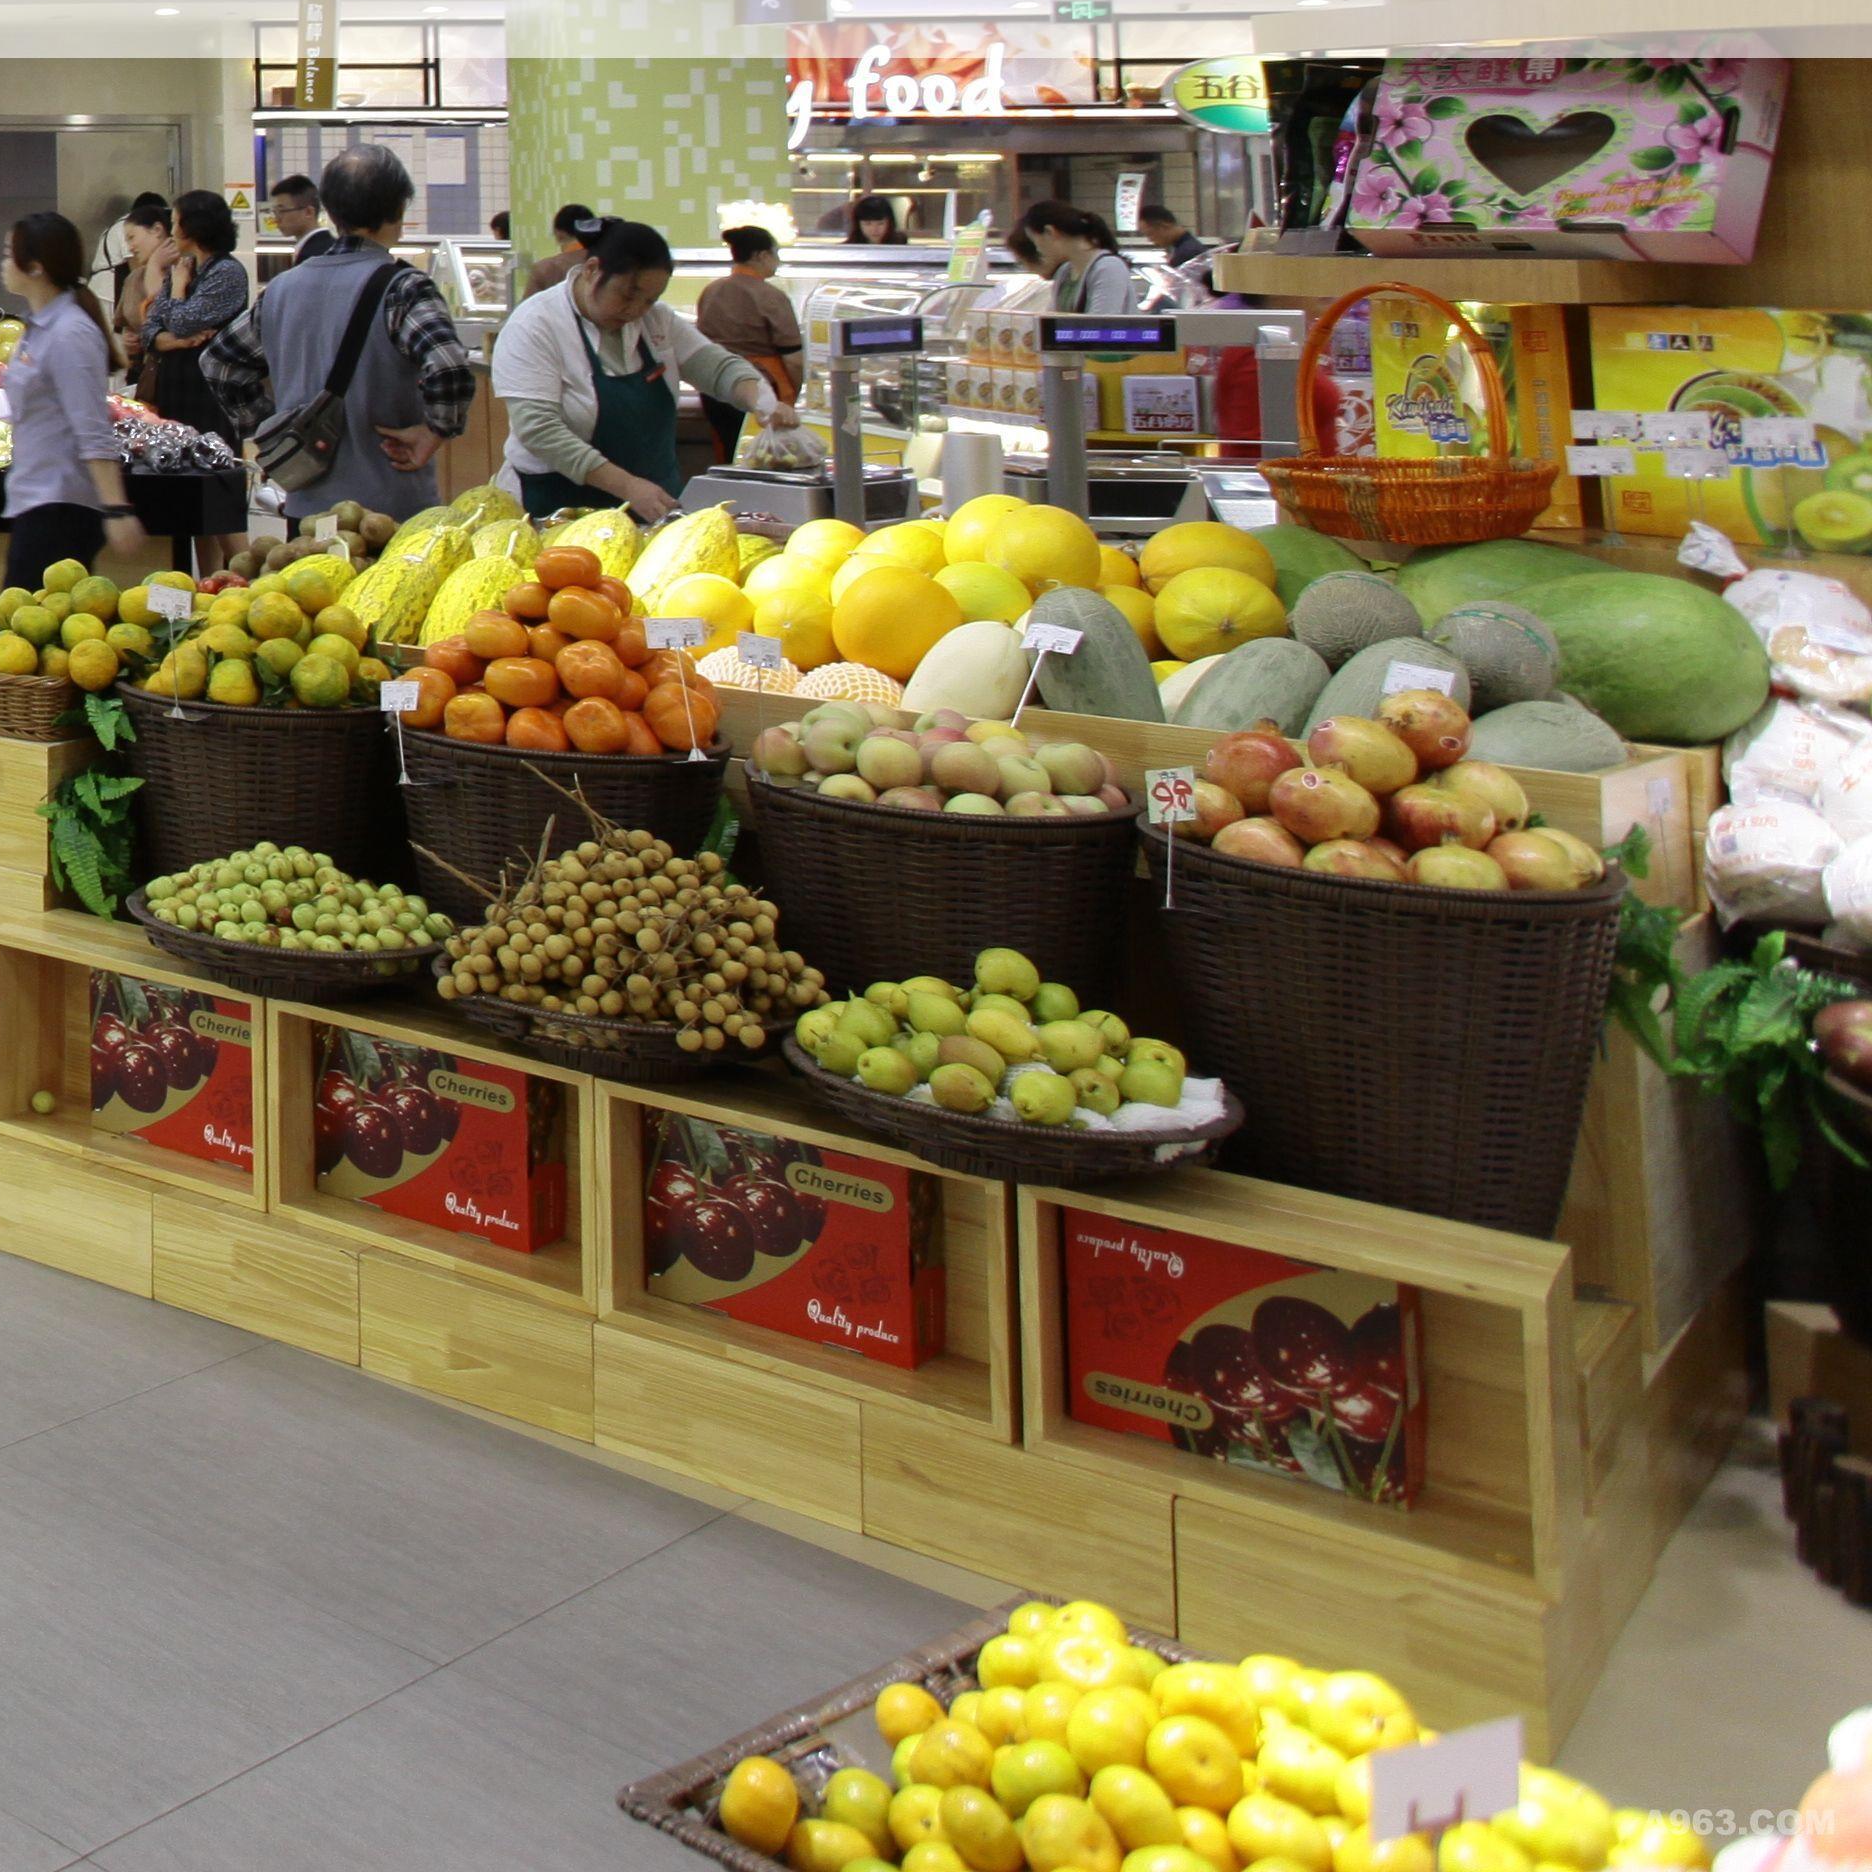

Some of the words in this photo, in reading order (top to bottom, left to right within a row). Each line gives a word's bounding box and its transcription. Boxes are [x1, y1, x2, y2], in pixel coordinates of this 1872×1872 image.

[304, 47, 320, 103] Balance
[848, 42, 1006, 119] food
[195, 1015, 250, 1040] Cherrie
[435, 1075, 507, 1106] Cherries
[204, 1124, 236, 1154] Quality
[795, 1168, 885, 1205] Cherries
[444, 1192, 482, 1225] Quality
[484, 1209, 520, 1231] produce
[1077, 1234, 1125, 1258] produce
[1130, 1240, 1184, 1278] Quality
[807, 1298, 852, 1336] Quality
[856, 1320, 899, 1344] produce
[1095, 1380, 1202, 1422] Cherries
